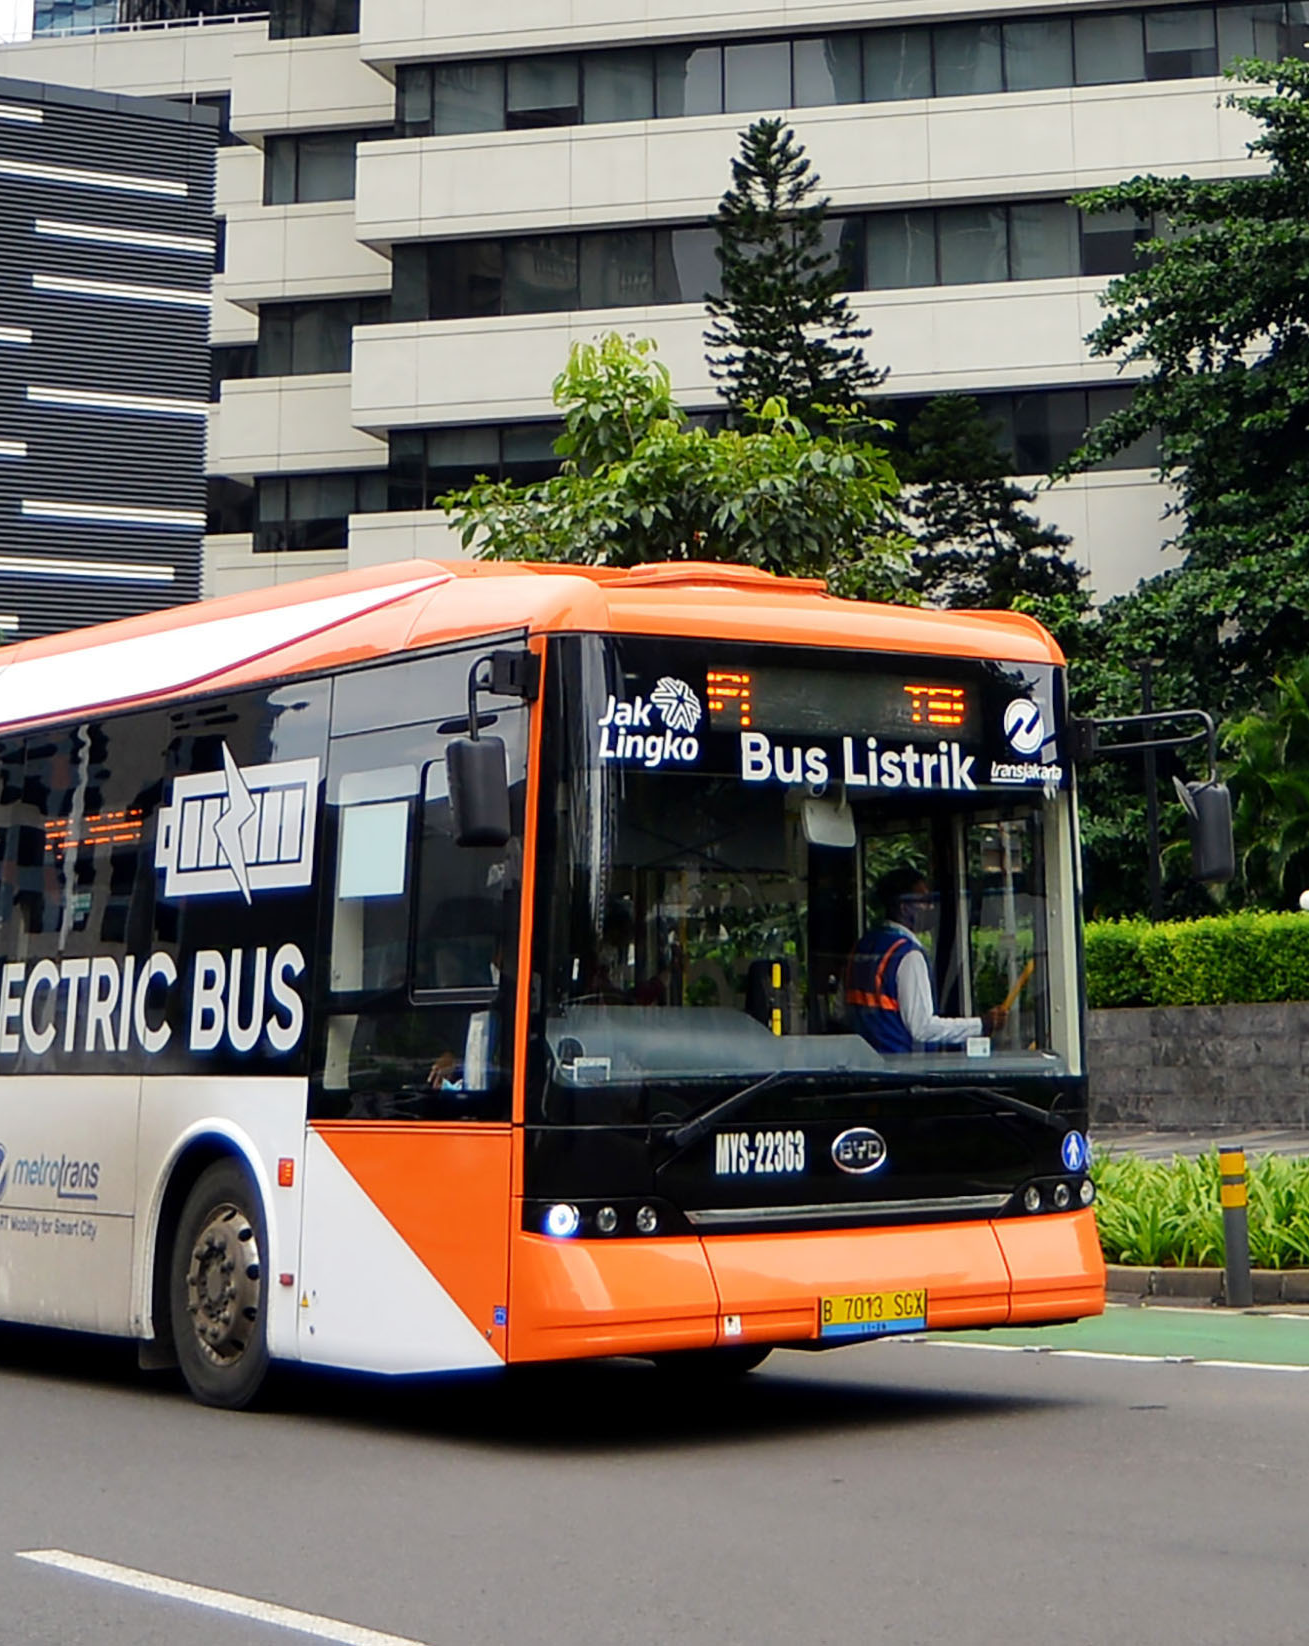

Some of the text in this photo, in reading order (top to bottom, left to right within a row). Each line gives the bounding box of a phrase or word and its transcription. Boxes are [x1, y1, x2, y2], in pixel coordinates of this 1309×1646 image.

[598, 694, 652, 726] Jak
[598, 727, 699, 767] Lingko
[740, 731, 978, 790] Bus Listrik
[990, 760, 1063, 783] transjakarta
[189, 943, 306, 1052] BUS
[715, 1130, 805, 1174] MYS-22363
[839, 1140, 881, 1161] BYD
[12, 1152, 100, 1200] metrotrans
[54, 1218, 79, 1236] Smart
[81, 1220, 97, 1241] City
[823, 1292, 924, 1322] B 7013 SGX
